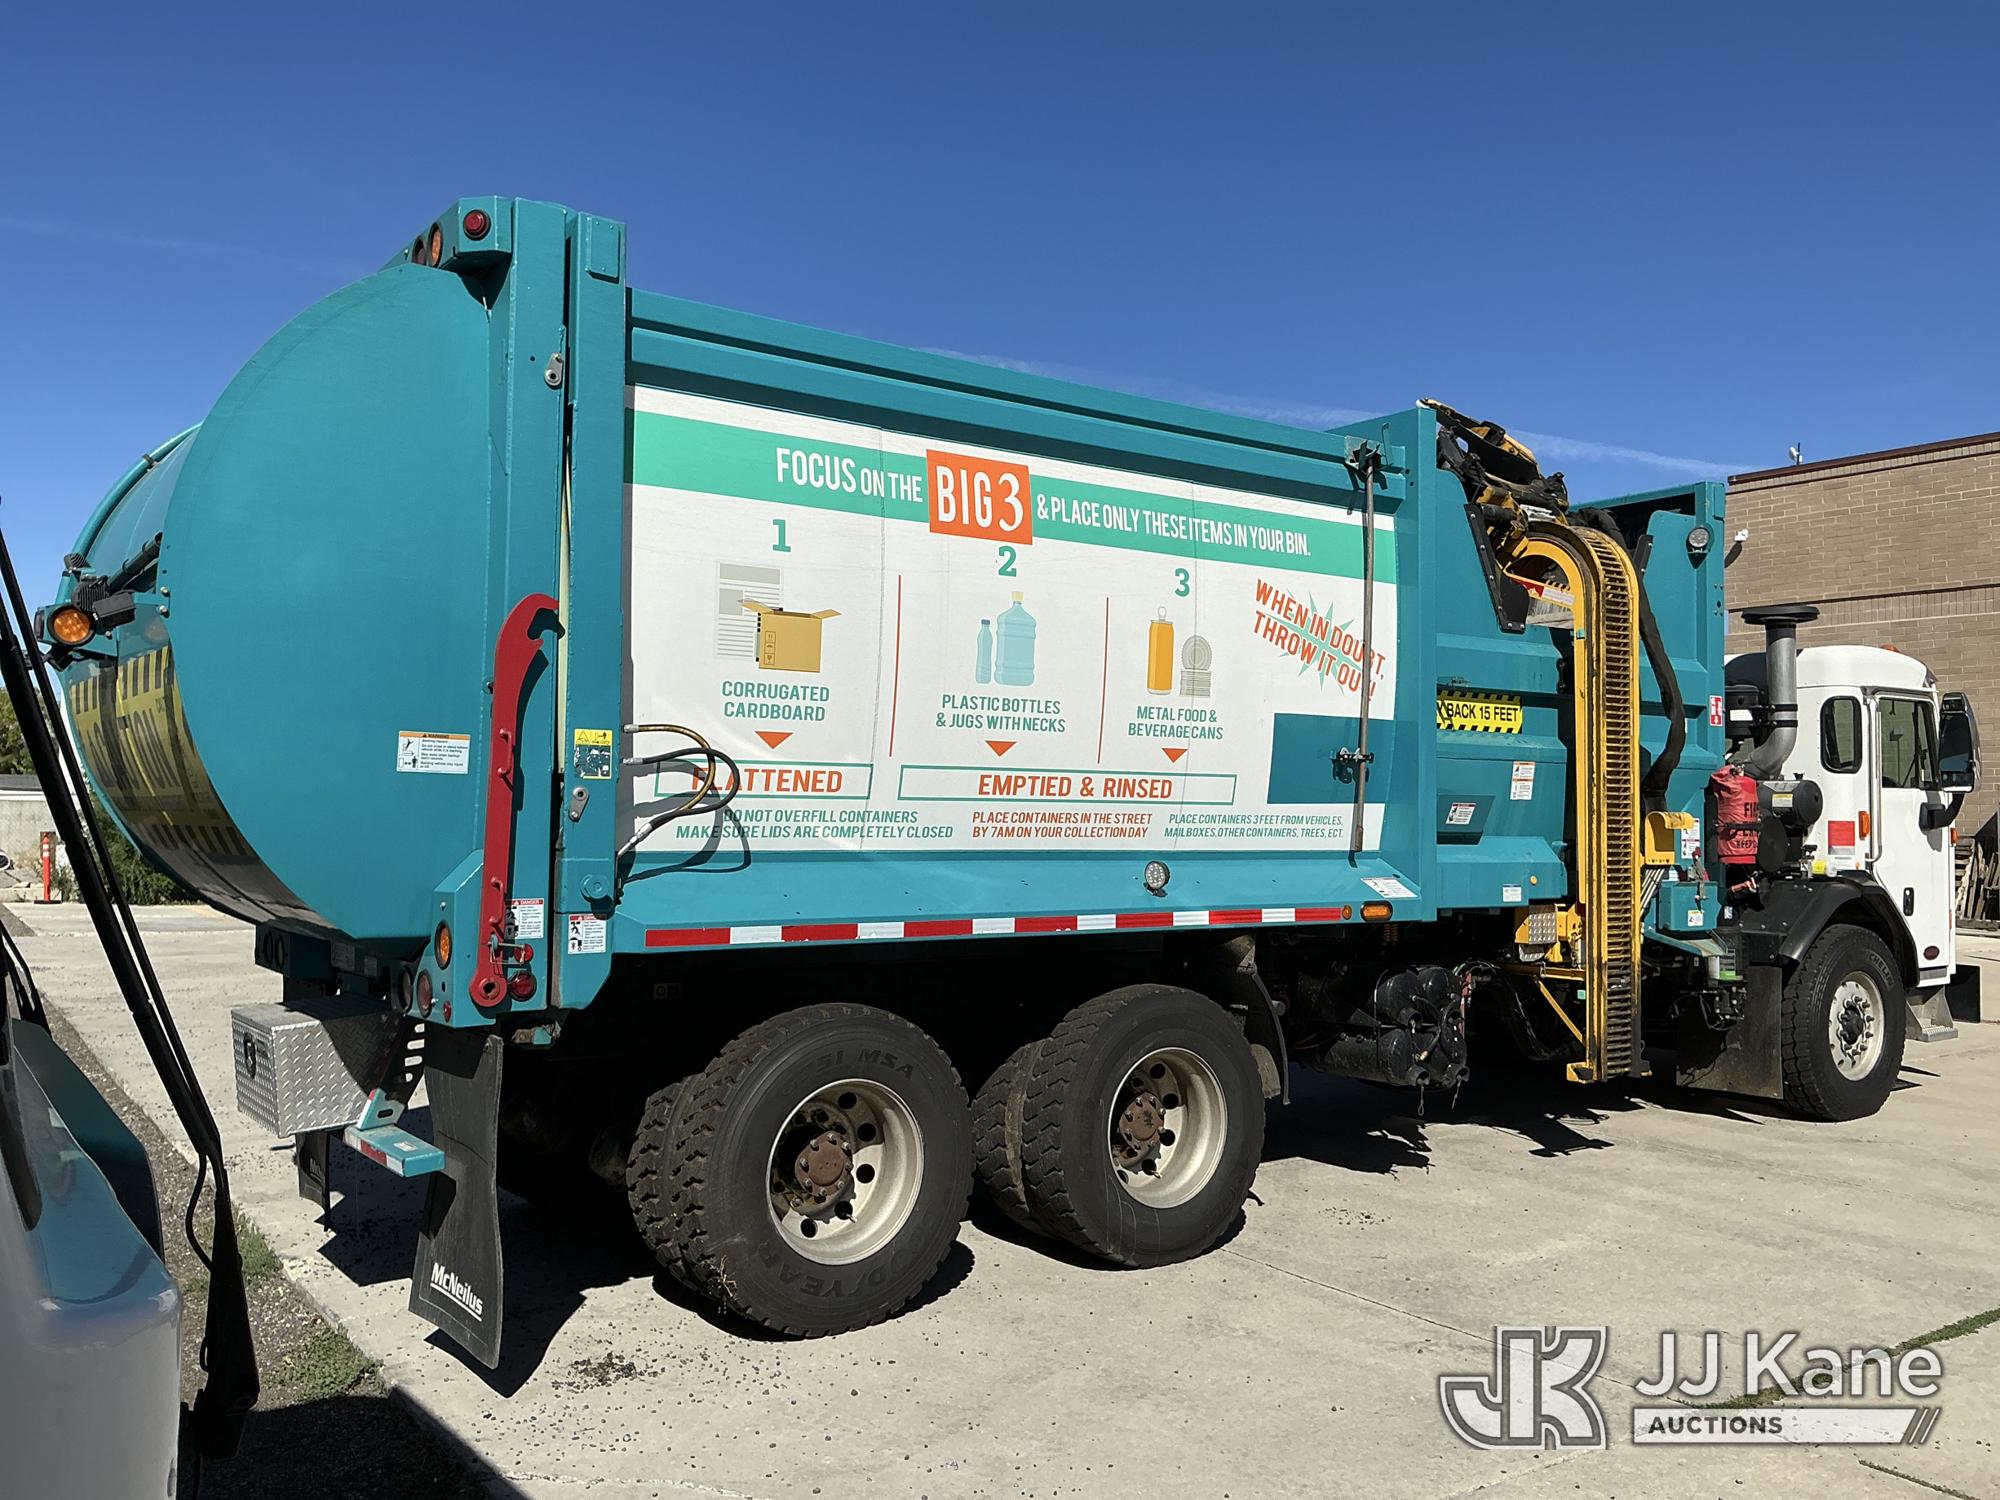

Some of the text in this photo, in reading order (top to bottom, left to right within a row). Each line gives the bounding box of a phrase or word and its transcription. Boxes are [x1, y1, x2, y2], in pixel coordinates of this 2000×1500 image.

[776, 447, 923, 503] FOCUS ON THE
[936, 465, 1023, 532] BIG 3
[772, 519, 791, 552] 1
[1037, 494, 1311, 557] & PLACE ONLY THESE ITEMS IN YOUR BIN.
[998, 545, 1017, 577] 2
[1174, 568, 1190, 596] 3
[1256, 578, 1309, 628] WHEN
[1310, 613, 1329, 641] IN
[1254, 610, 1376, 702] THROW IT OU!
[722, 681, 830, 702] CORRUGATED
[724, 701, 825, 722] CARDBOARD
[942, 694, 1060, 714] PLASTIC BOTTLES
[1137, 706, 1217, 722] METAL FOOD &
[1446, 703, 1476, 719] BACK
[1480, 705, 1490, 720] 15
[1494, 708, 1518, 722] FEET
[936, 712, 1065, 732] & JUGS WITH NECKS
[1128, 723, 1223, 739] BEVERAGE CANS
[692, 767, 843, 793] FATTENED
[978, 774, 1173, 798] EMPTIED & RINSED
[724, 809, 918, 823] DO NOT OVERFILL CONTAINERS
[973, 812, 1152, 824] PLACE CONTAINERS IN THE STREET
[1169, 814, 1198, 824] PLACE
[1198, 814, 1251, 825] CONTAINERS
[1253, 815, 1259, 824] 3
[1259, 815, 1280, 825] FEET
[1280, 815, 1303, 825] FROM
[676, 825, 953, 838] MAKE SURE LIDS ARE COMPLETELY CLOSED
[973, 826, 1148, 838] BY 7AM ON YOUR COLLECTION DAY
[1218, 828, 1245, 838] OTHER
[431, 1262, 484, 1316] McNeilus
